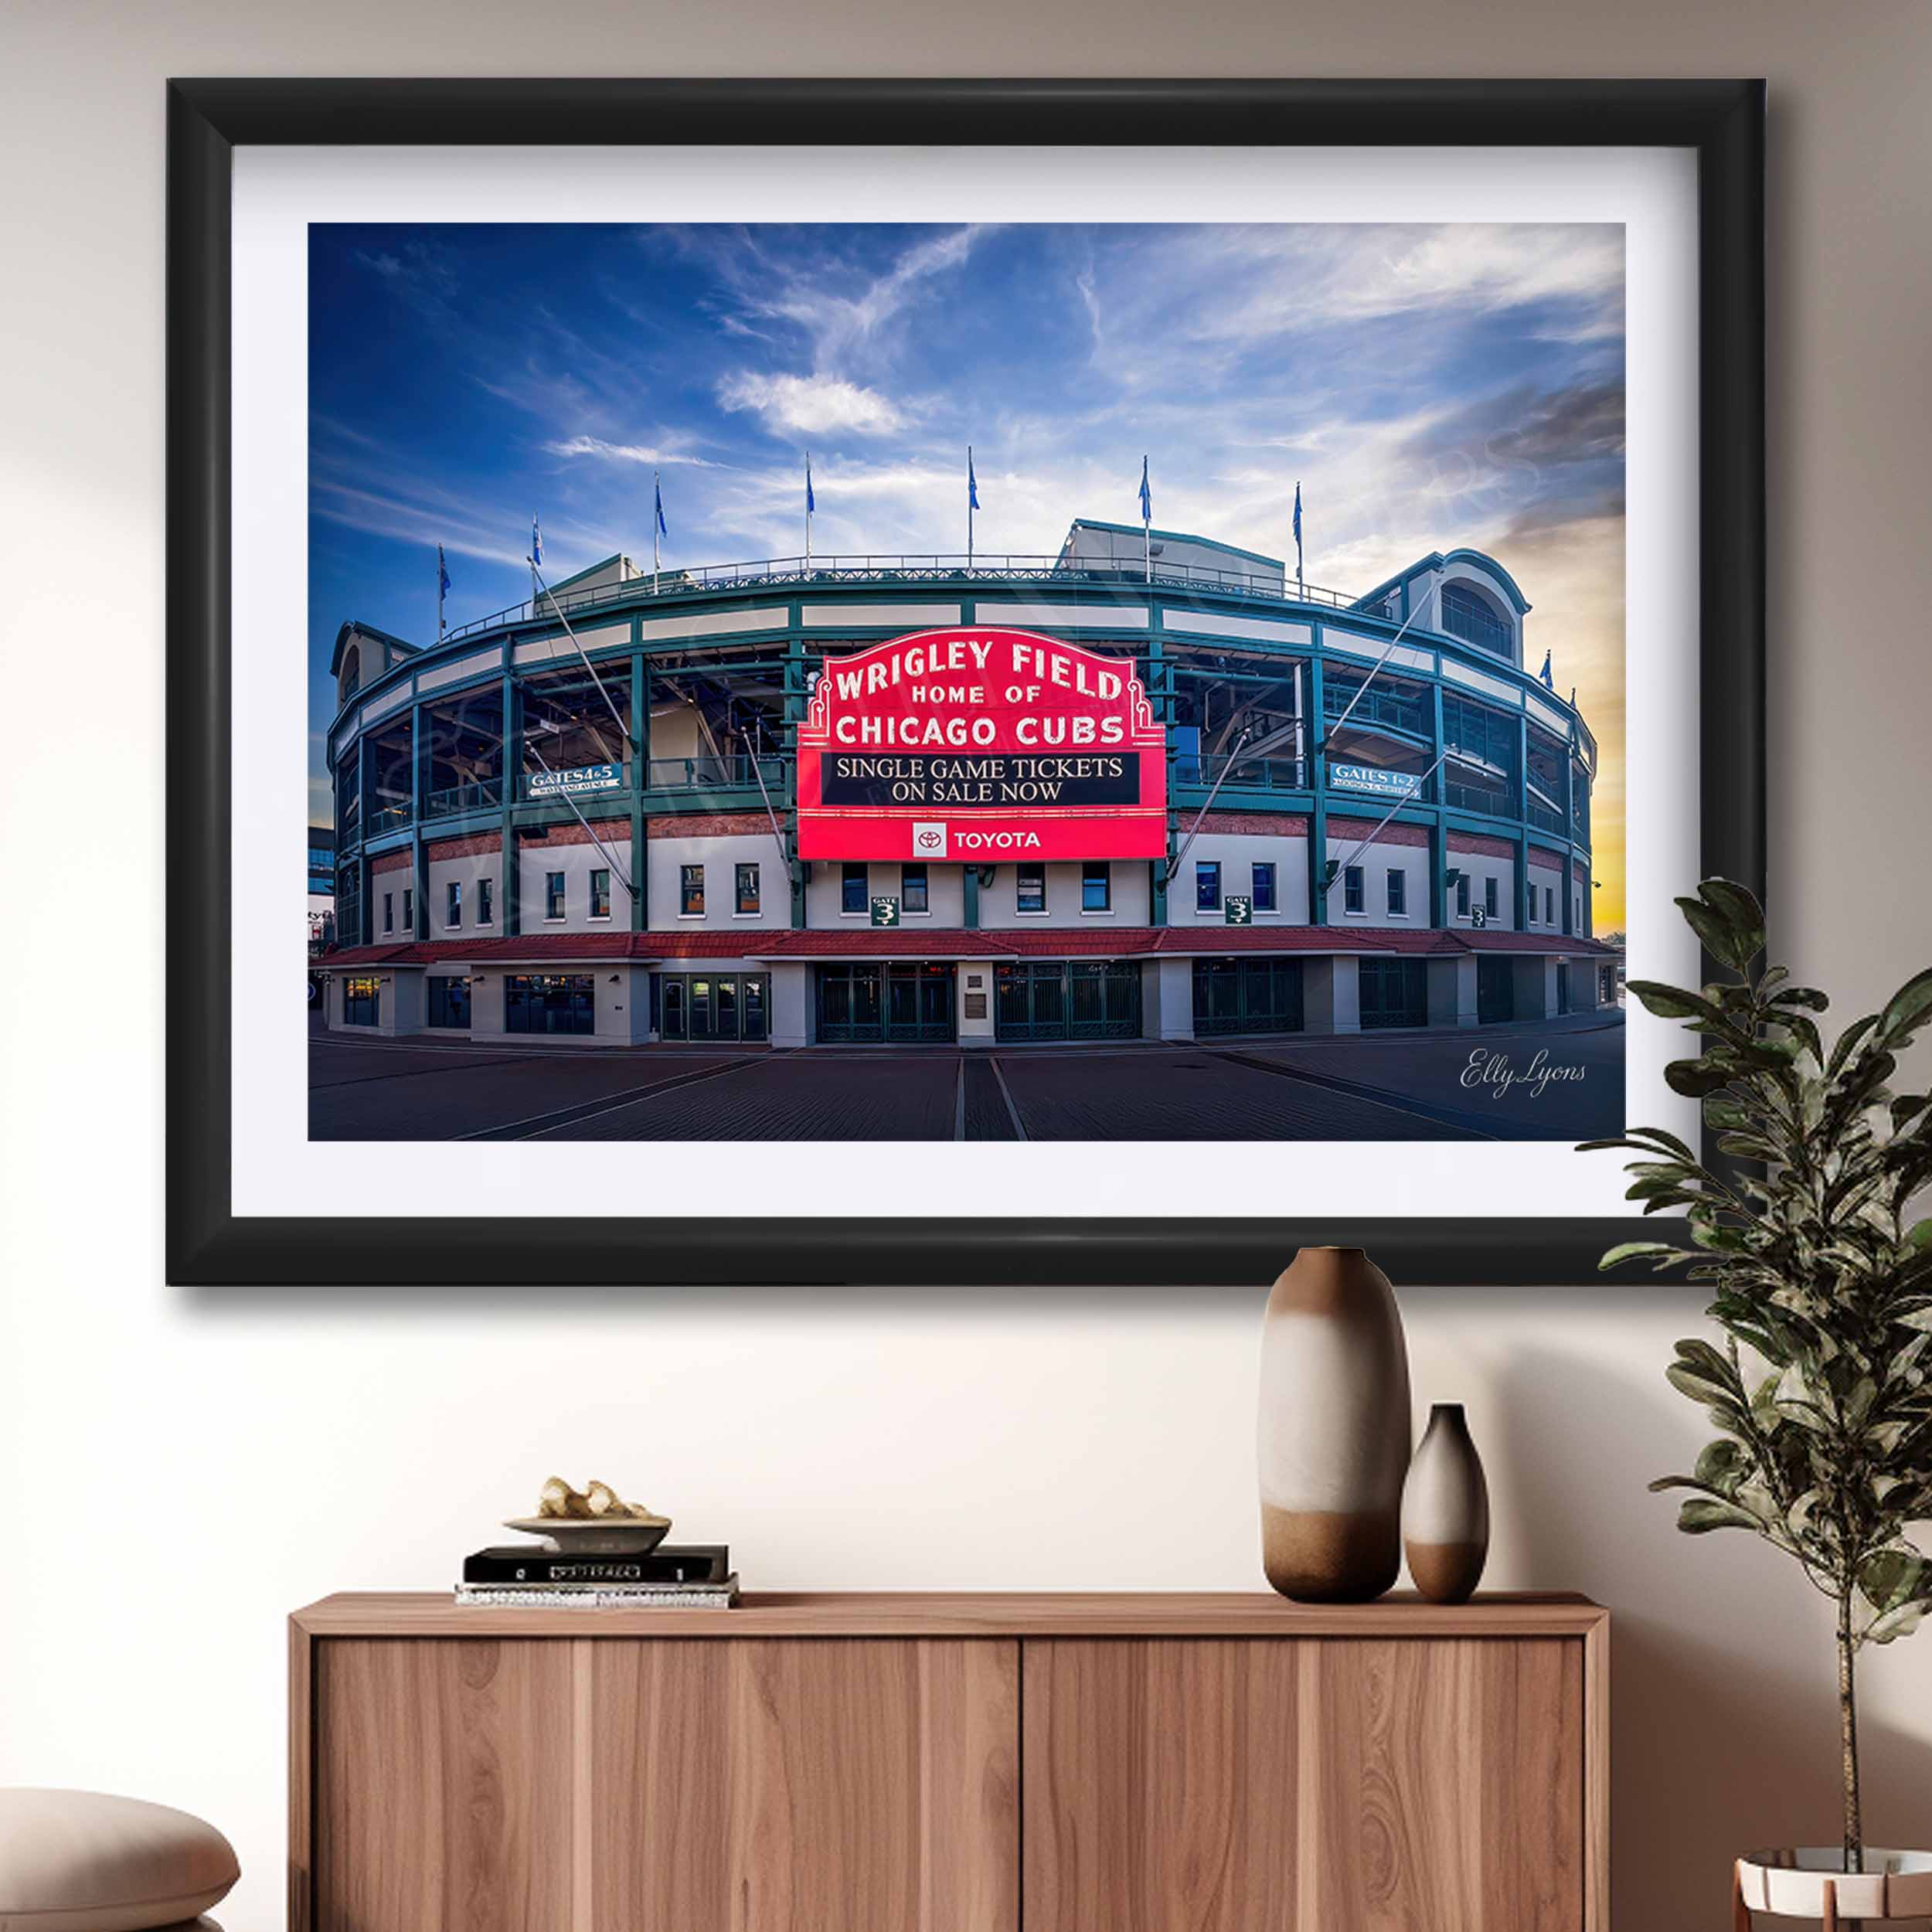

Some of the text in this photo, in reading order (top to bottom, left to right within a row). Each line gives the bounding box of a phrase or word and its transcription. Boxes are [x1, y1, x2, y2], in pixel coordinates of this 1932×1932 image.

[835, 641, 1122, 701] WRIGLEY FIELD
[911, 685, 1042, 704] HOME OF
[835, 715, 1124, 746] CHICAGO CUBS
[532, 770, 584, 786] GATES
[837, 757, 1124, 780] SINGLE GAME TICKETS
[1335, 765, 1388, 784] GATES
[892, 781, 926, 801] ON
[933, 782, 994, 802] SALE
[1000, 781, 1063, 801] NOW
[954, 832, 1042, 849] TOYOTA
[876, 903, 895, 920] 3
[1230, 903, 1247, 919] 3
[1474, 909, 1484, 923] 3
[1460, 1048, 1587, 1100] Elly Lyons
